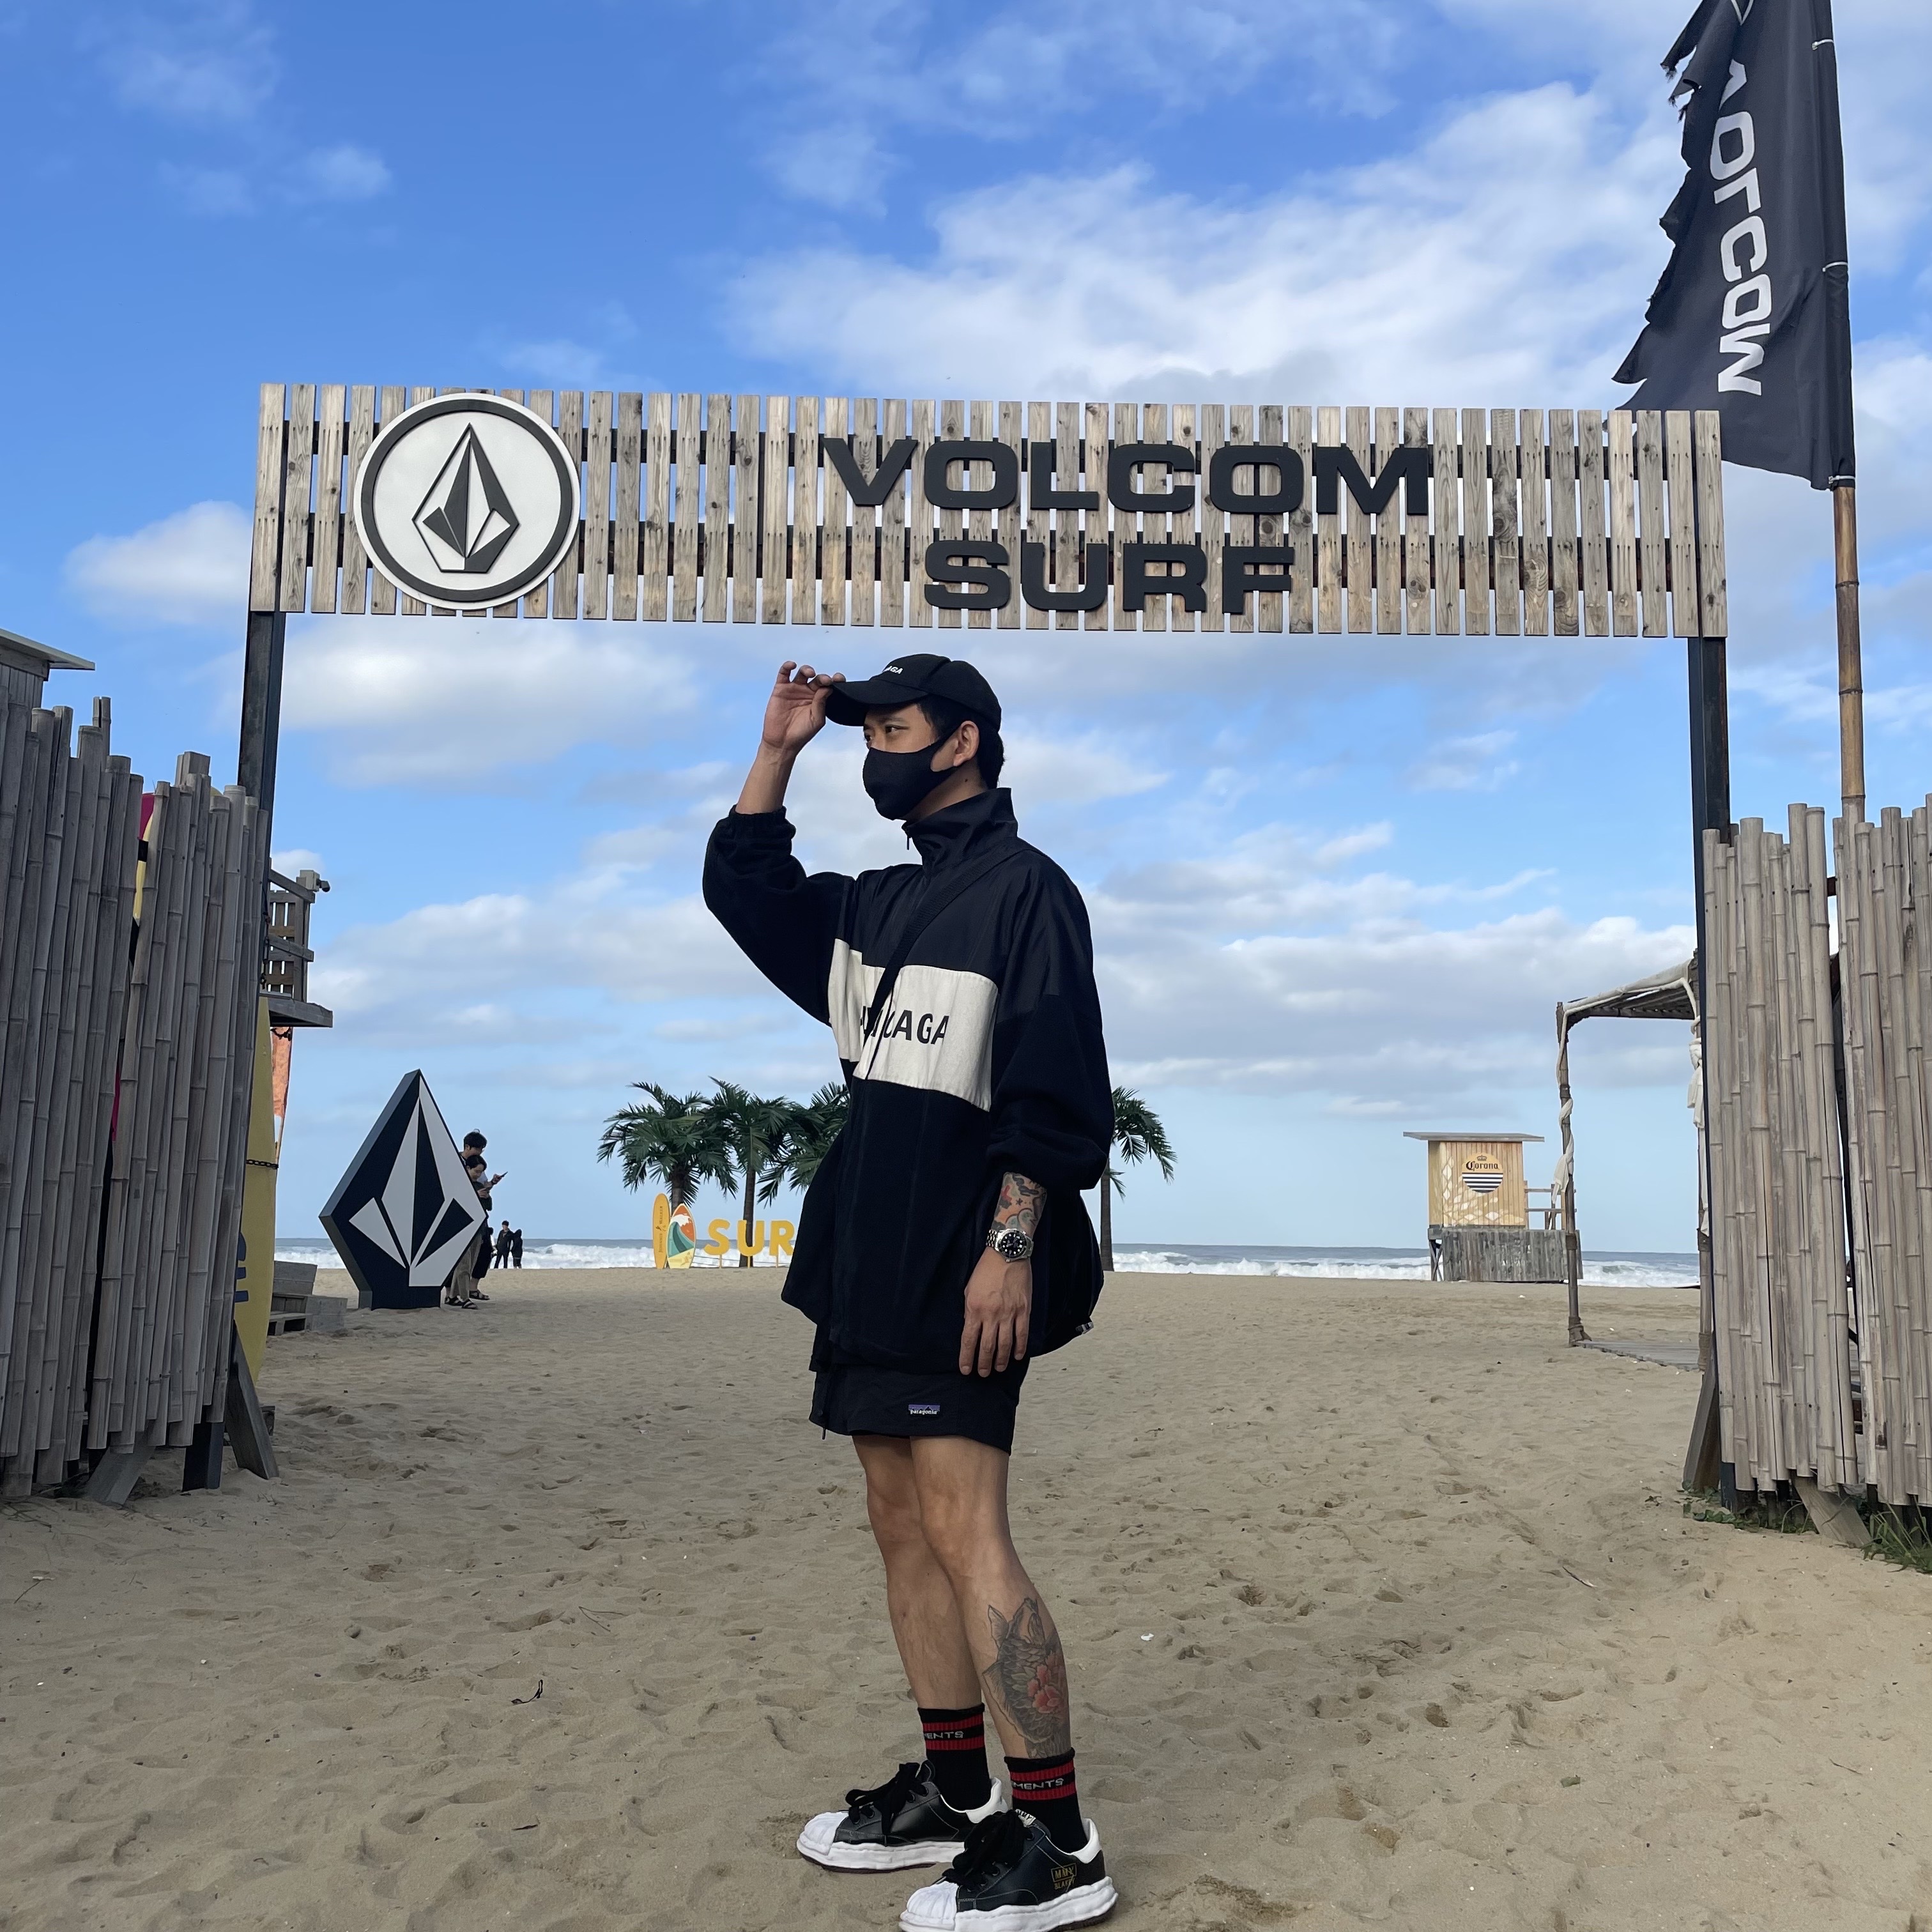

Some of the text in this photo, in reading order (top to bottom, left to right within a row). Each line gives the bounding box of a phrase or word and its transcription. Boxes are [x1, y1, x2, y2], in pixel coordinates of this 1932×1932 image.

[822, 438, 1429, 516] VOLCOM
[923, 539, 1294, 615] SURF
[1466, 1160, 1500, 1171] Corona
[1011, 1778, 1064, 1790] MENTS
